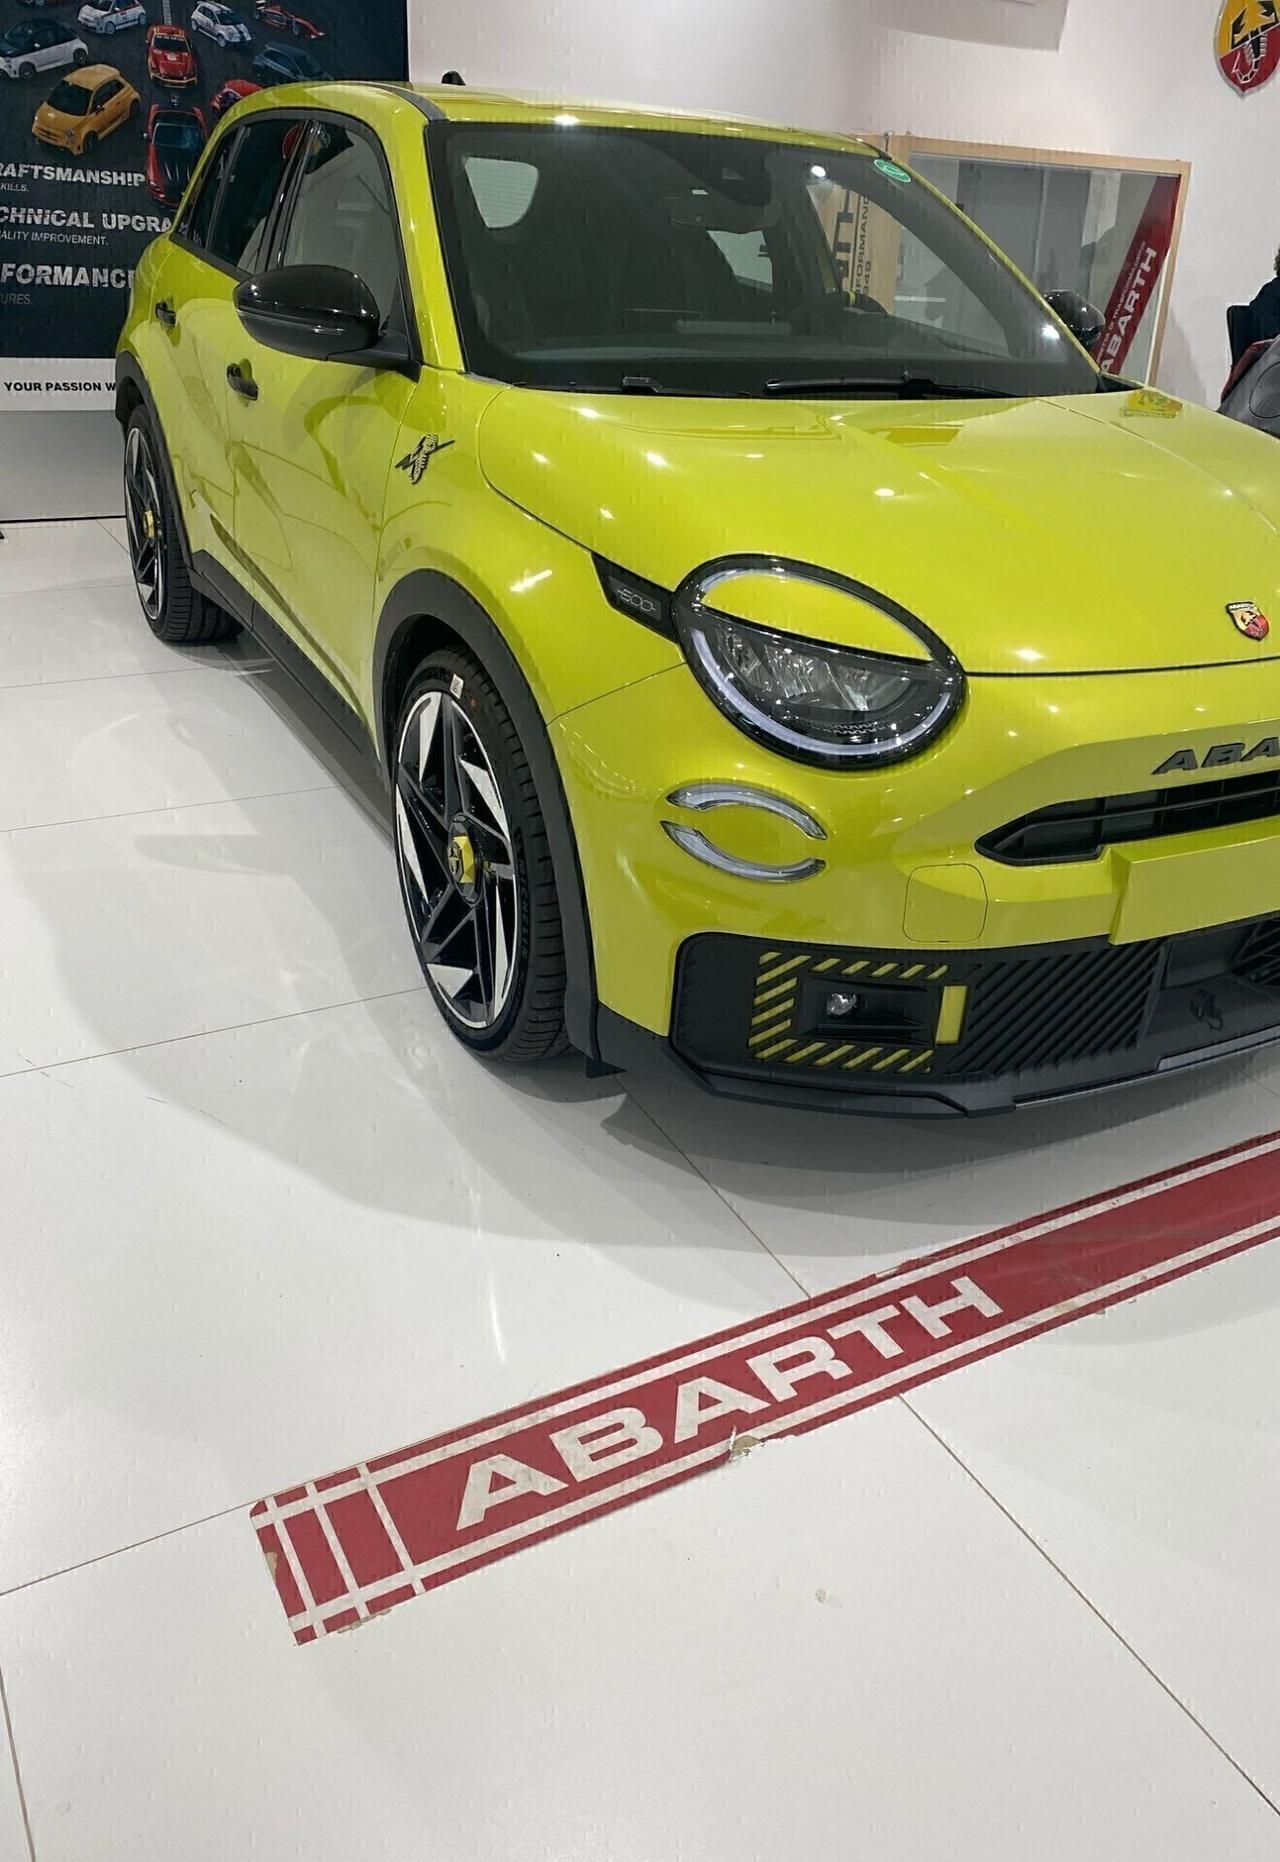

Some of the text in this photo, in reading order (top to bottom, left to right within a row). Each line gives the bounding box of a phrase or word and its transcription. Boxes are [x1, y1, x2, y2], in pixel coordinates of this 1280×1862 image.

[31, 232, 108, 246] IMPROVEMENT.
[1100, 247, 1157, 372] ABARTH
[4, 382, 42, 391] YOUR
[46, 382, 101, 391] PASSION
[1151, 737, 1280, 775] ABA
[455, 1276, 1003, 1531] ABARTH
